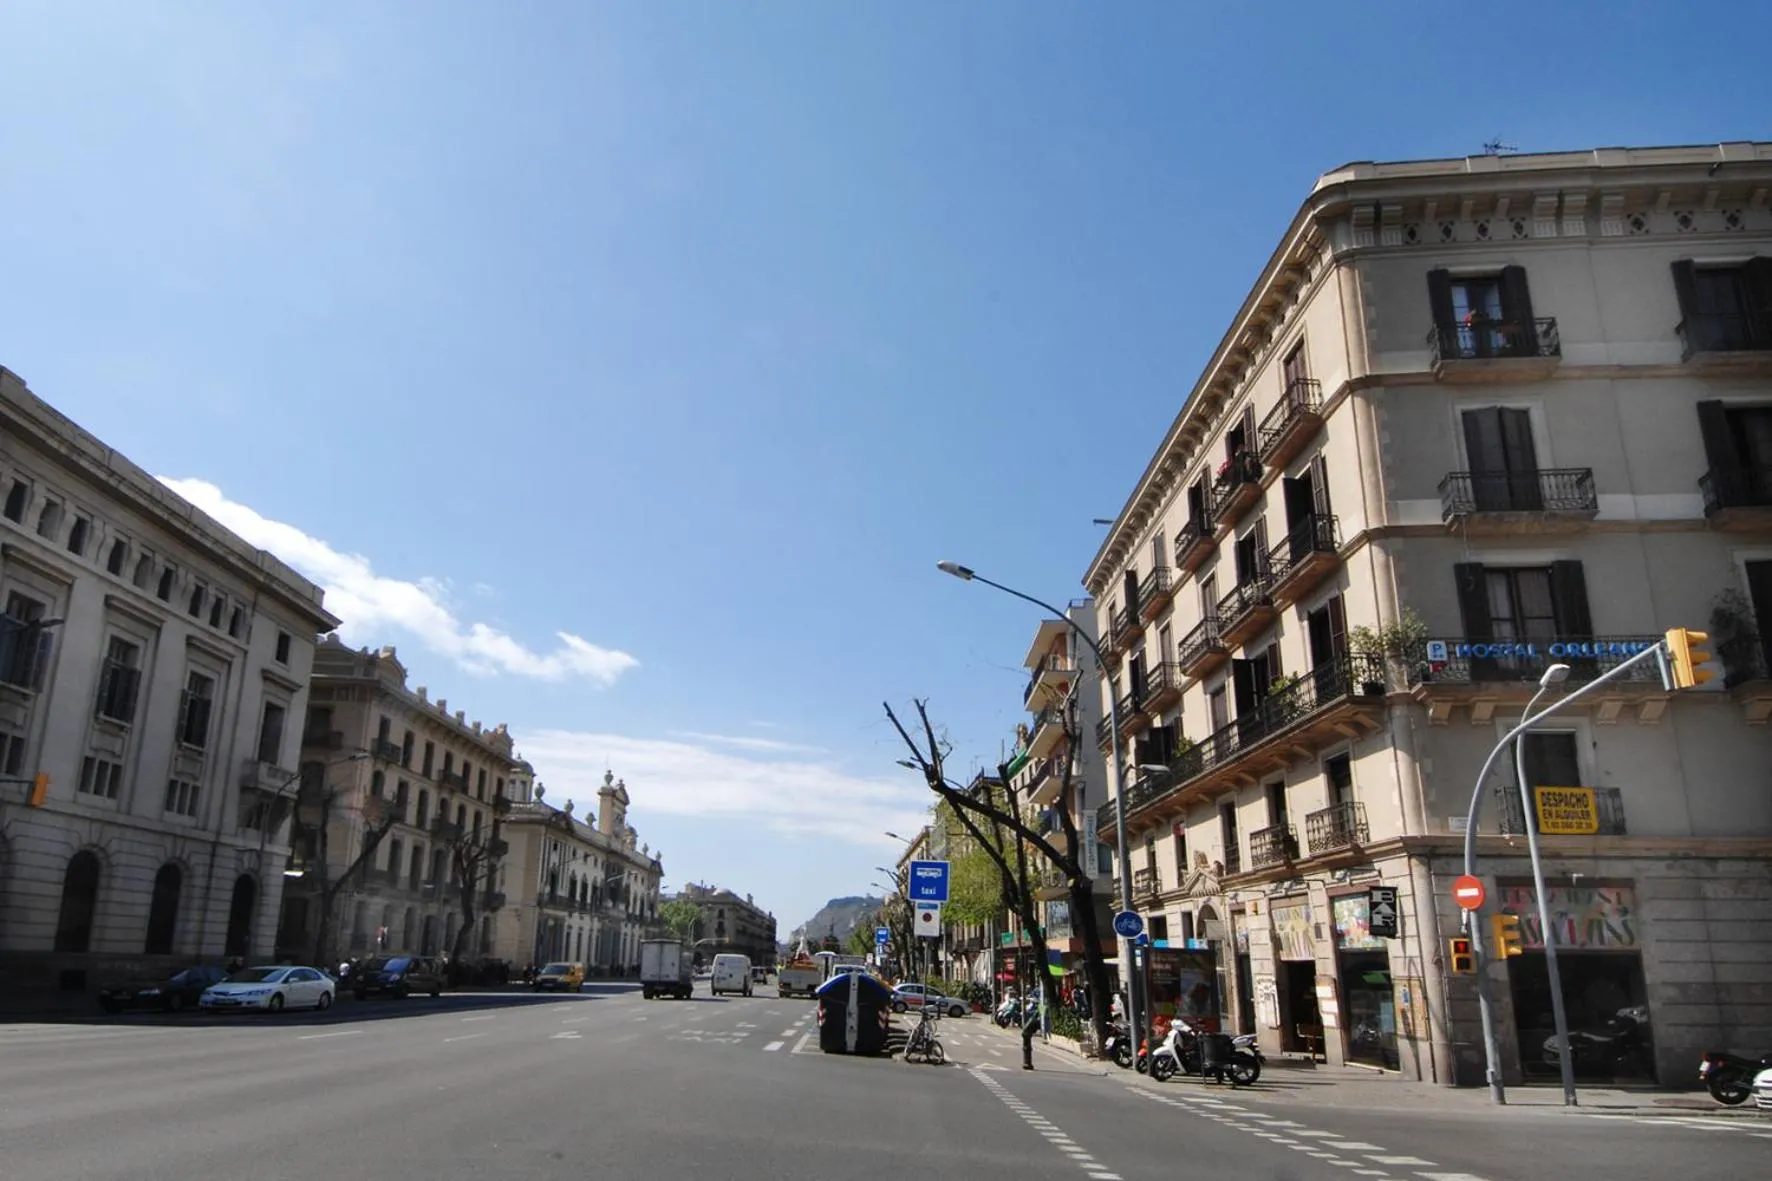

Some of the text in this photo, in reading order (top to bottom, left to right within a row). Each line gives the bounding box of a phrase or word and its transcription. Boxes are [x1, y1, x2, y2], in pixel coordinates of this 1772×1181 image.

[1456, 642, 1537, 658] HOSTAL
[1540, 791, 1590, 808] DESPACHO
[1542, 809, 1591, 820] EN ALQUILER
[921, 886, 937, 895] taxi
[1371, 890, 1396, 927] BAR
